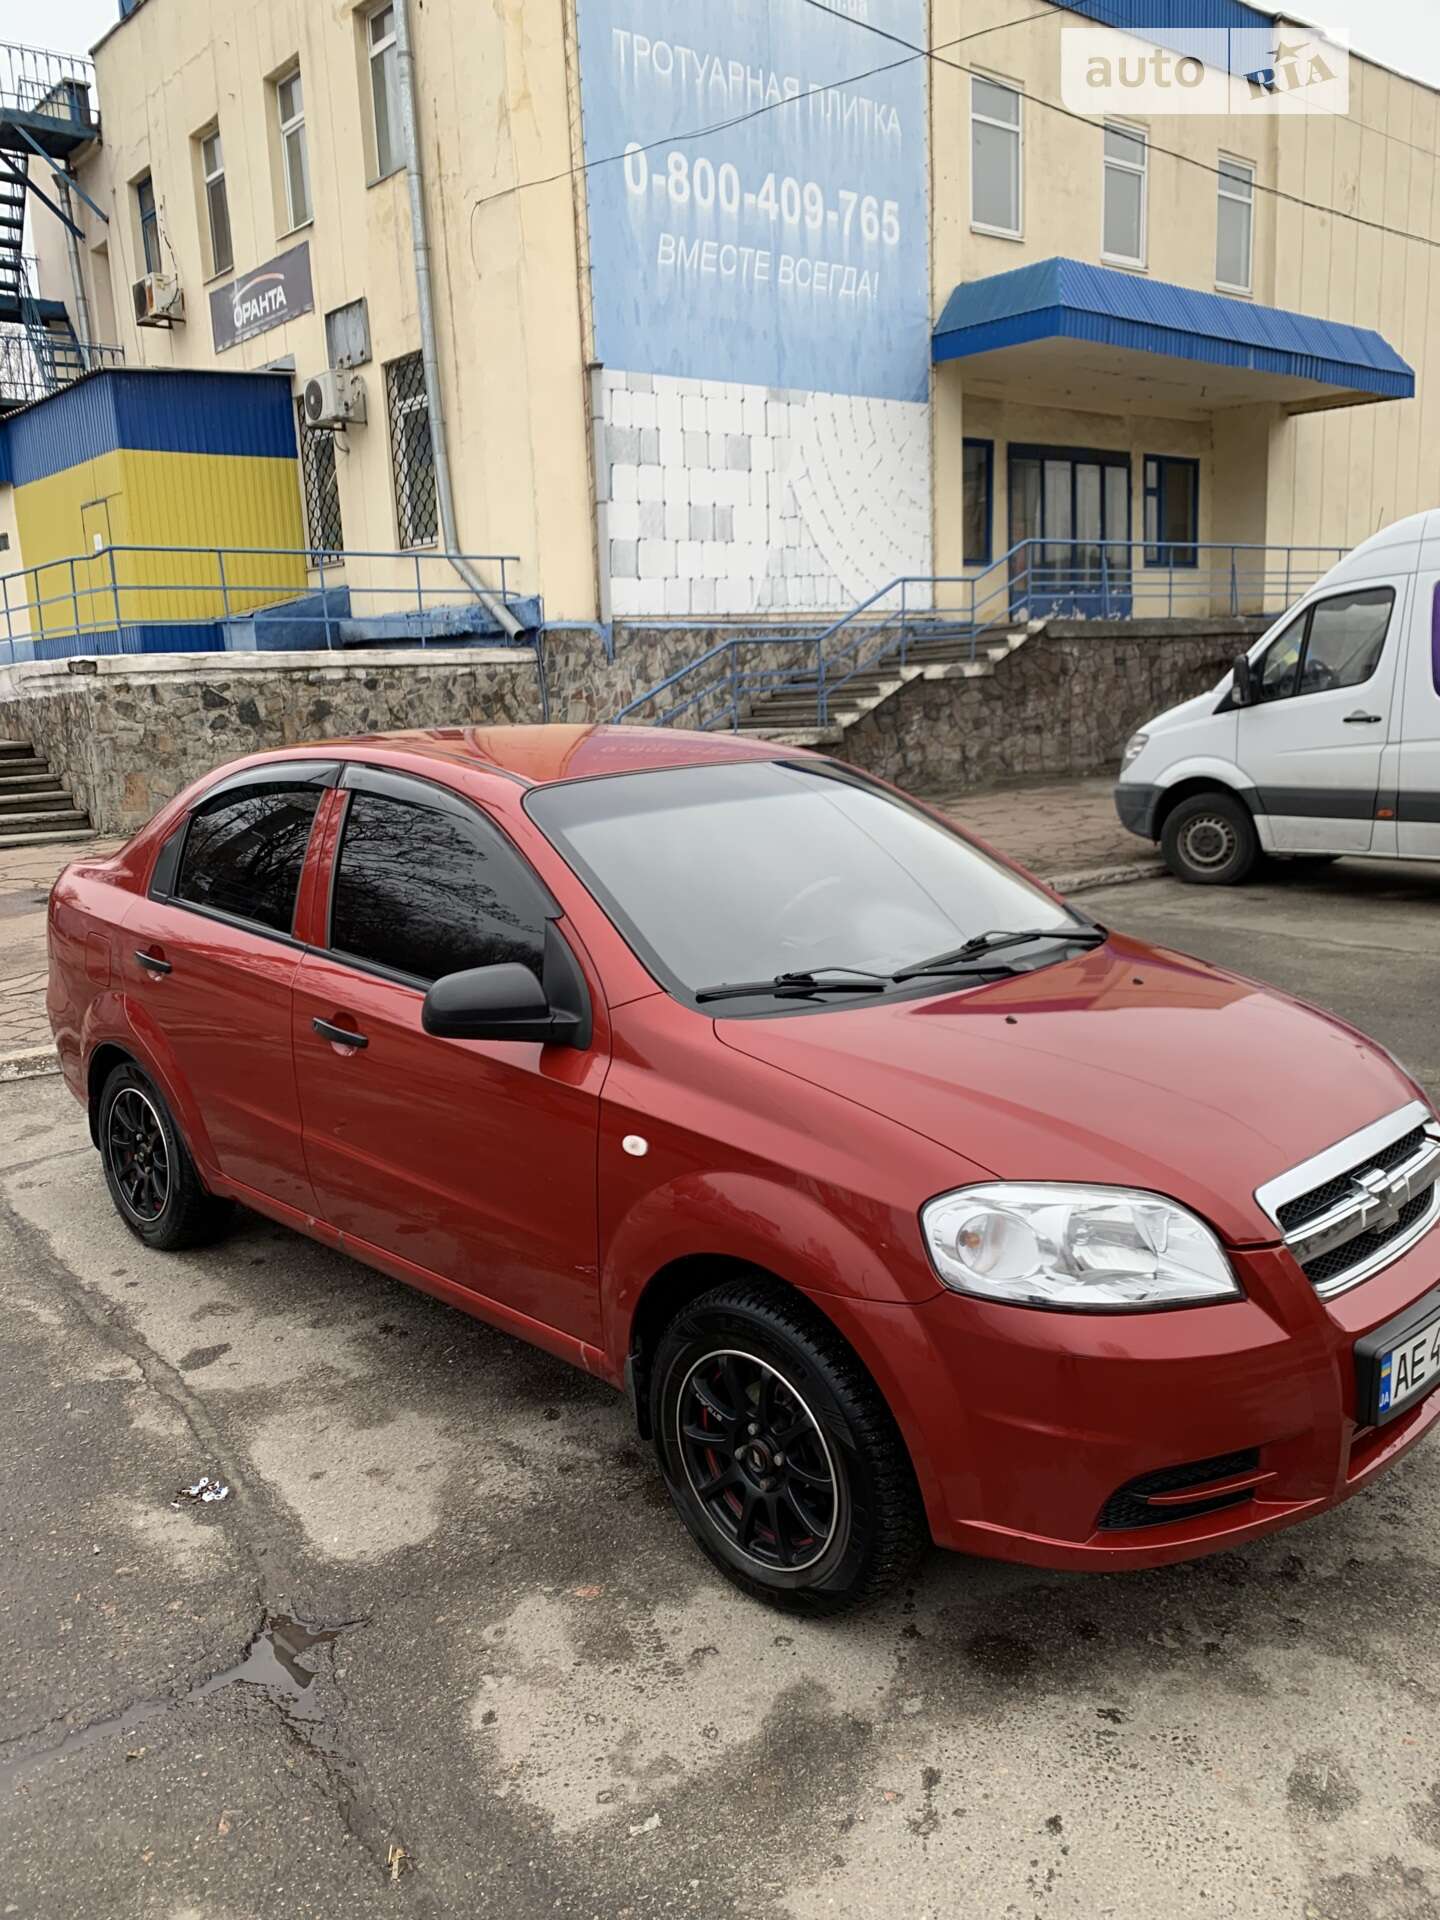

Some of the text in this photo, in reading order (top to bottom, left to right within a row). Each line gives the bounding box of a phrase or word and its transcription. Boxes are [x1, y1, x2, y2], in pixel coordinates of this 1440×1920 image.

[612, 28, 902, 137] ТРОТУАРНАЯ ПЛИТКА
[623, 142, 900, 245] 0-800-409-765
[234, 285, 287, 328] ОРАНТА
[657, 233, 880, 299] ВМЕСТЕ ВСЕГДА!
